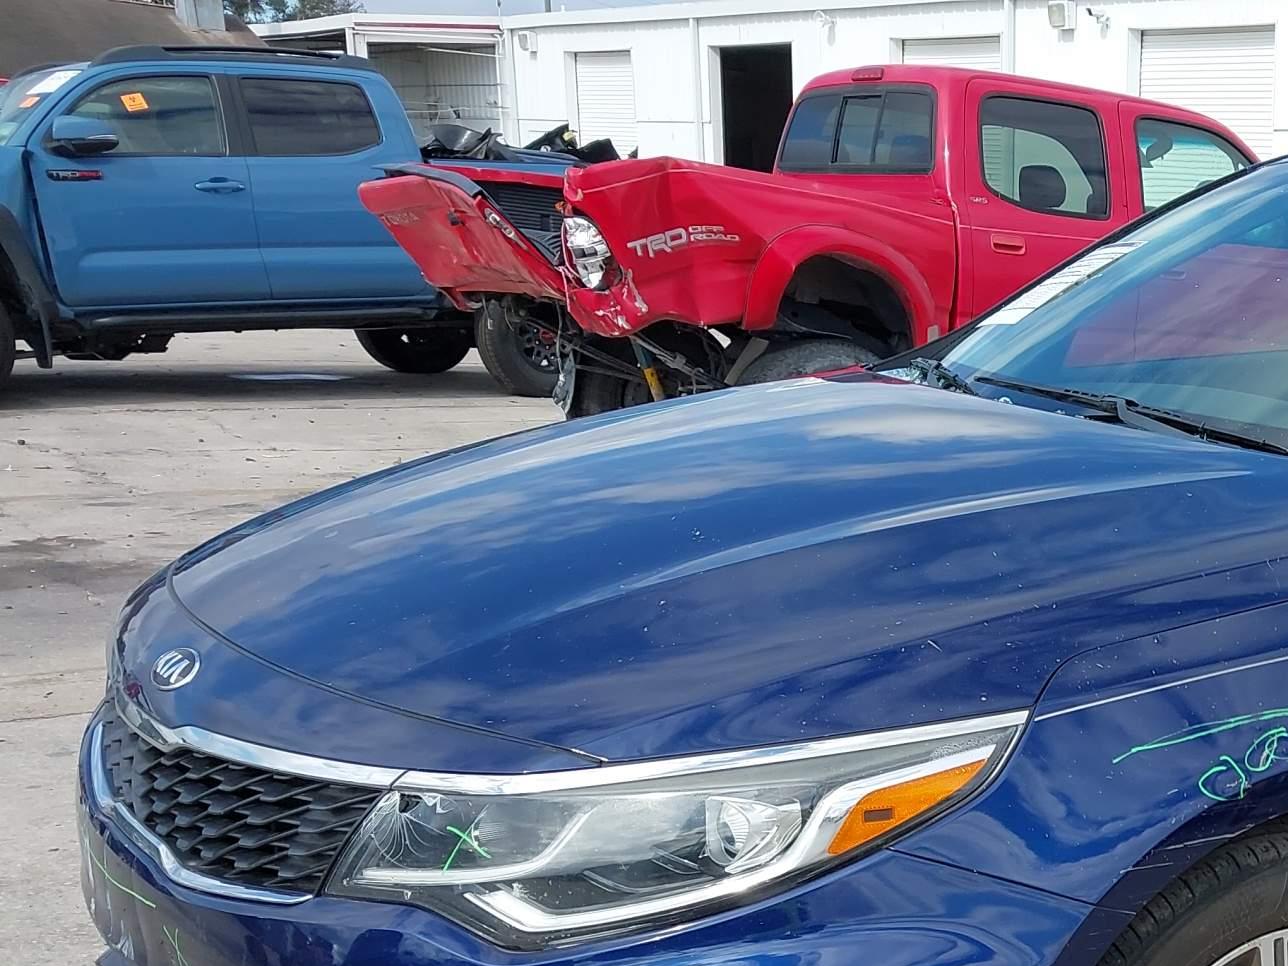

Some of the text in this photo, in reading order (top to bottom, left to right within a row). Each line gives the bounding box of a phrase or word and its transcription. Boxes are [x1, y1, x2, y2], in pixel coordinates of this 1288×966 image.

[688, 225, 724, 233] OFF
[690, 233, 740, 242] ROAD
[626, 227, 687, 259] TRD
